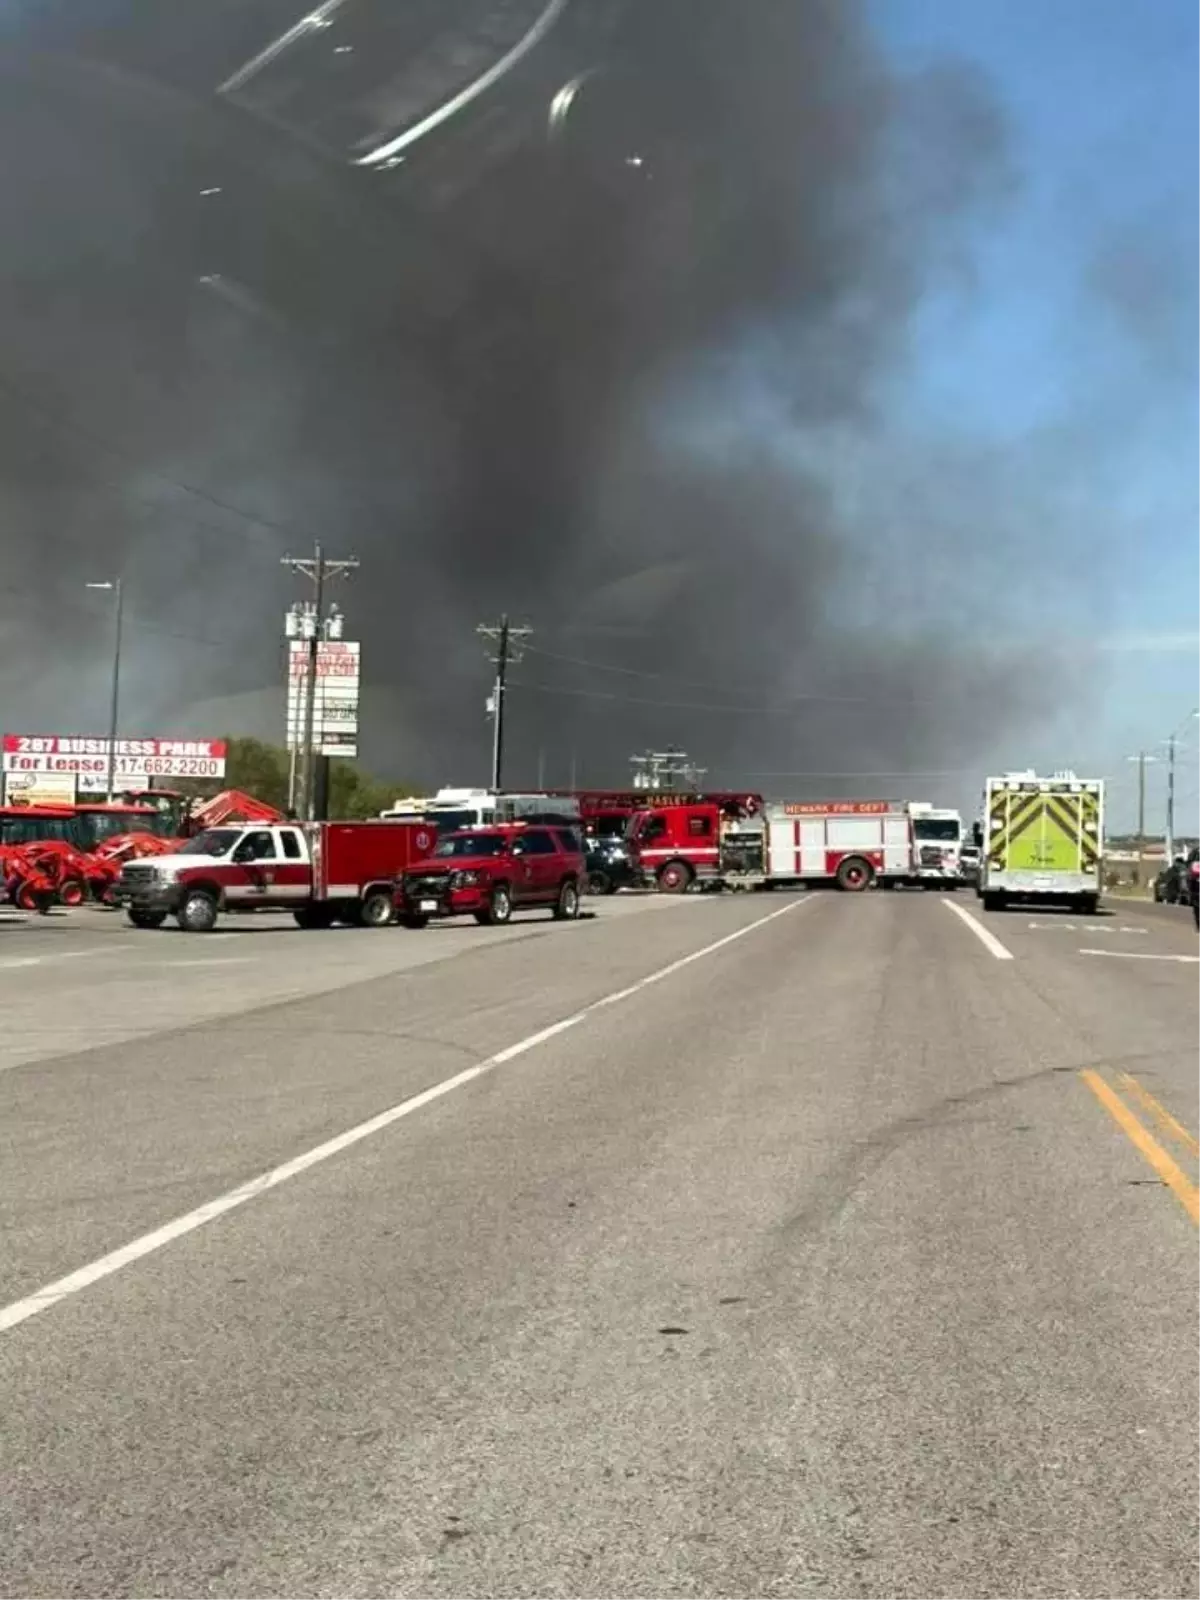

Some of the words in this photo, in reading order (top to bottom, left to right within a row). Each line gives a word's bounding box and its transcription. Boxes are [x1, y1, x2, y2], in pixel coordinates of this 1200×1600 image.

[17, 737, 55, 753] 287
[57, 738, 156, 756] BUSINESS
[159, 740, 211, 758] PARK
[10, 755, 40, 770] For
[46, 756, 105, 772] Lease
[786, 803, 828, 814] NEWARK
[833, 803, 854, 813] FIRE
